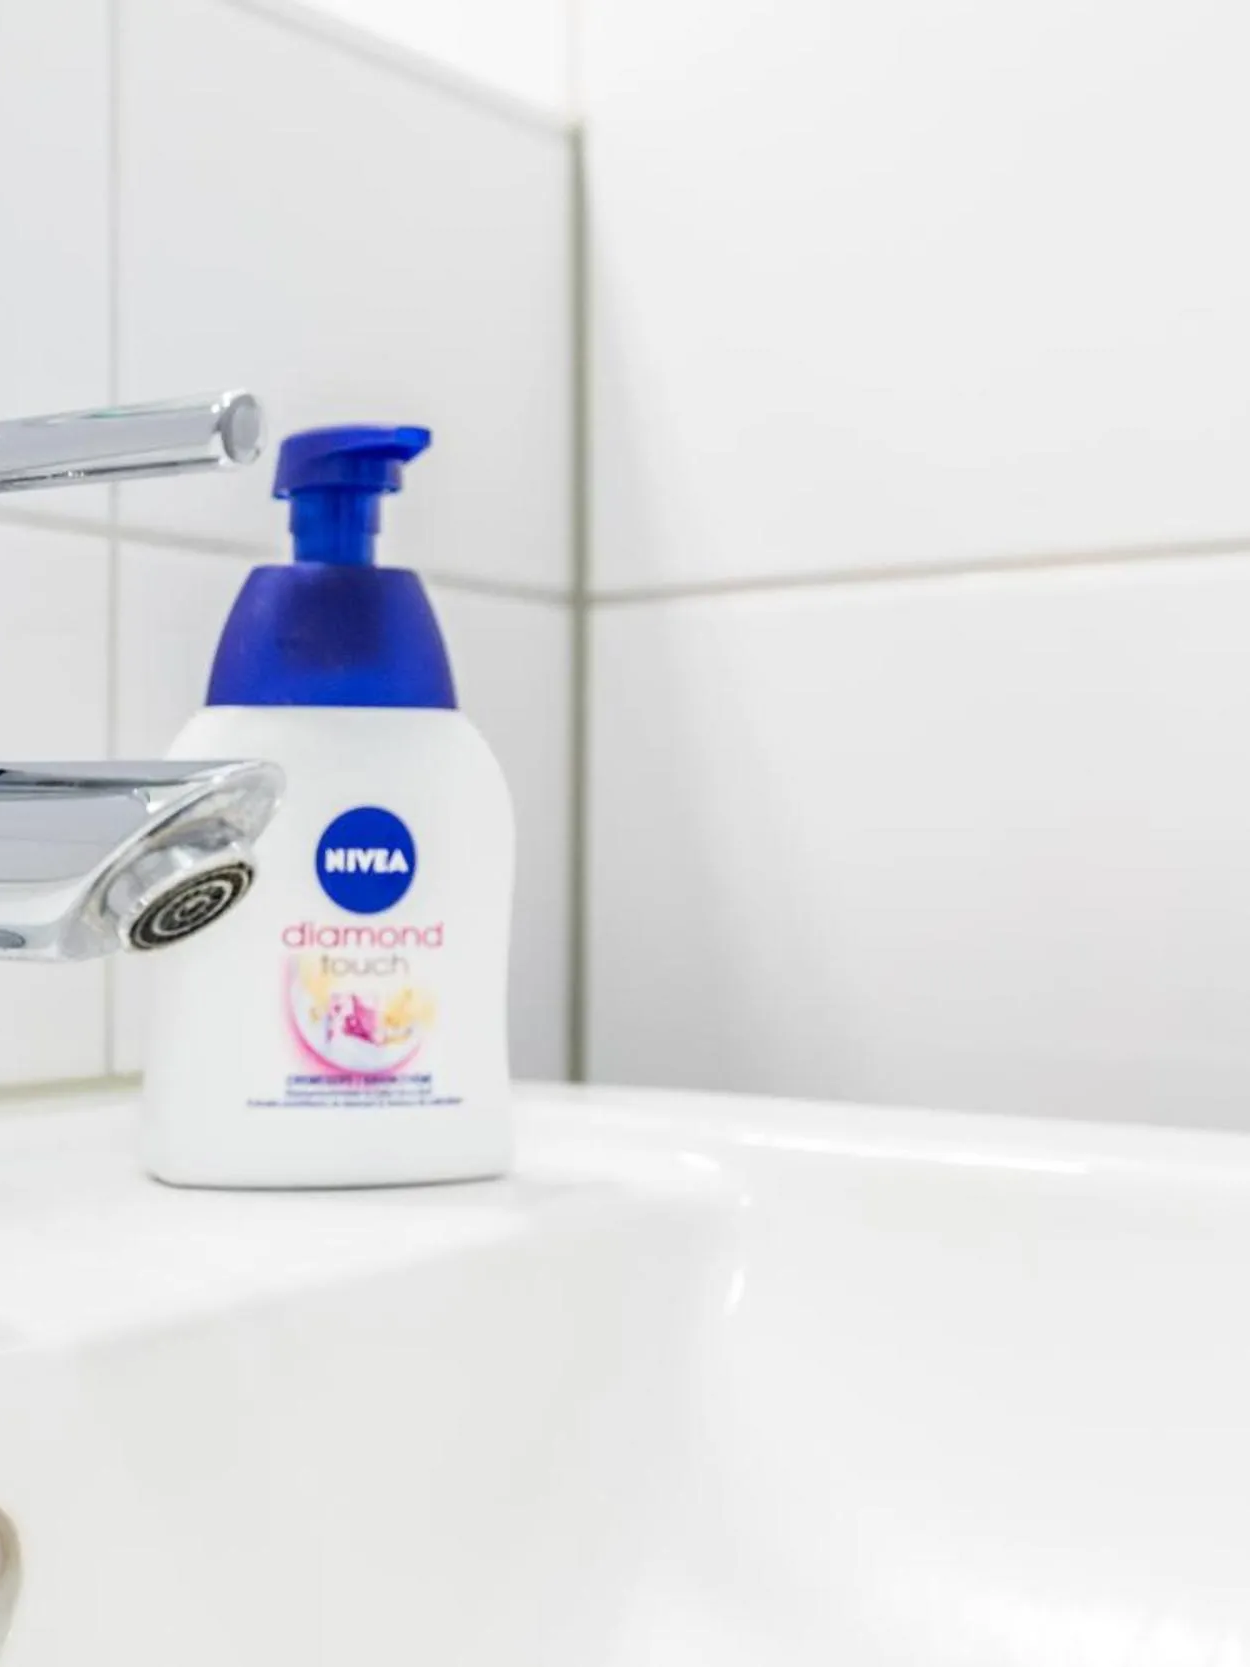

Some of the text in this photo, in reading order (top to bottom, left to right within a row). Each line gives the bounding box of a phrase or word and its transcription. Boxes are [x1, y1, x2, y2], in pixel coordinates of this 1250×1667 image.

[324, 848, 409, 873] NIVEA
[281, 921, 444, 949] diamond
[321, 953, 410, 976] touch
